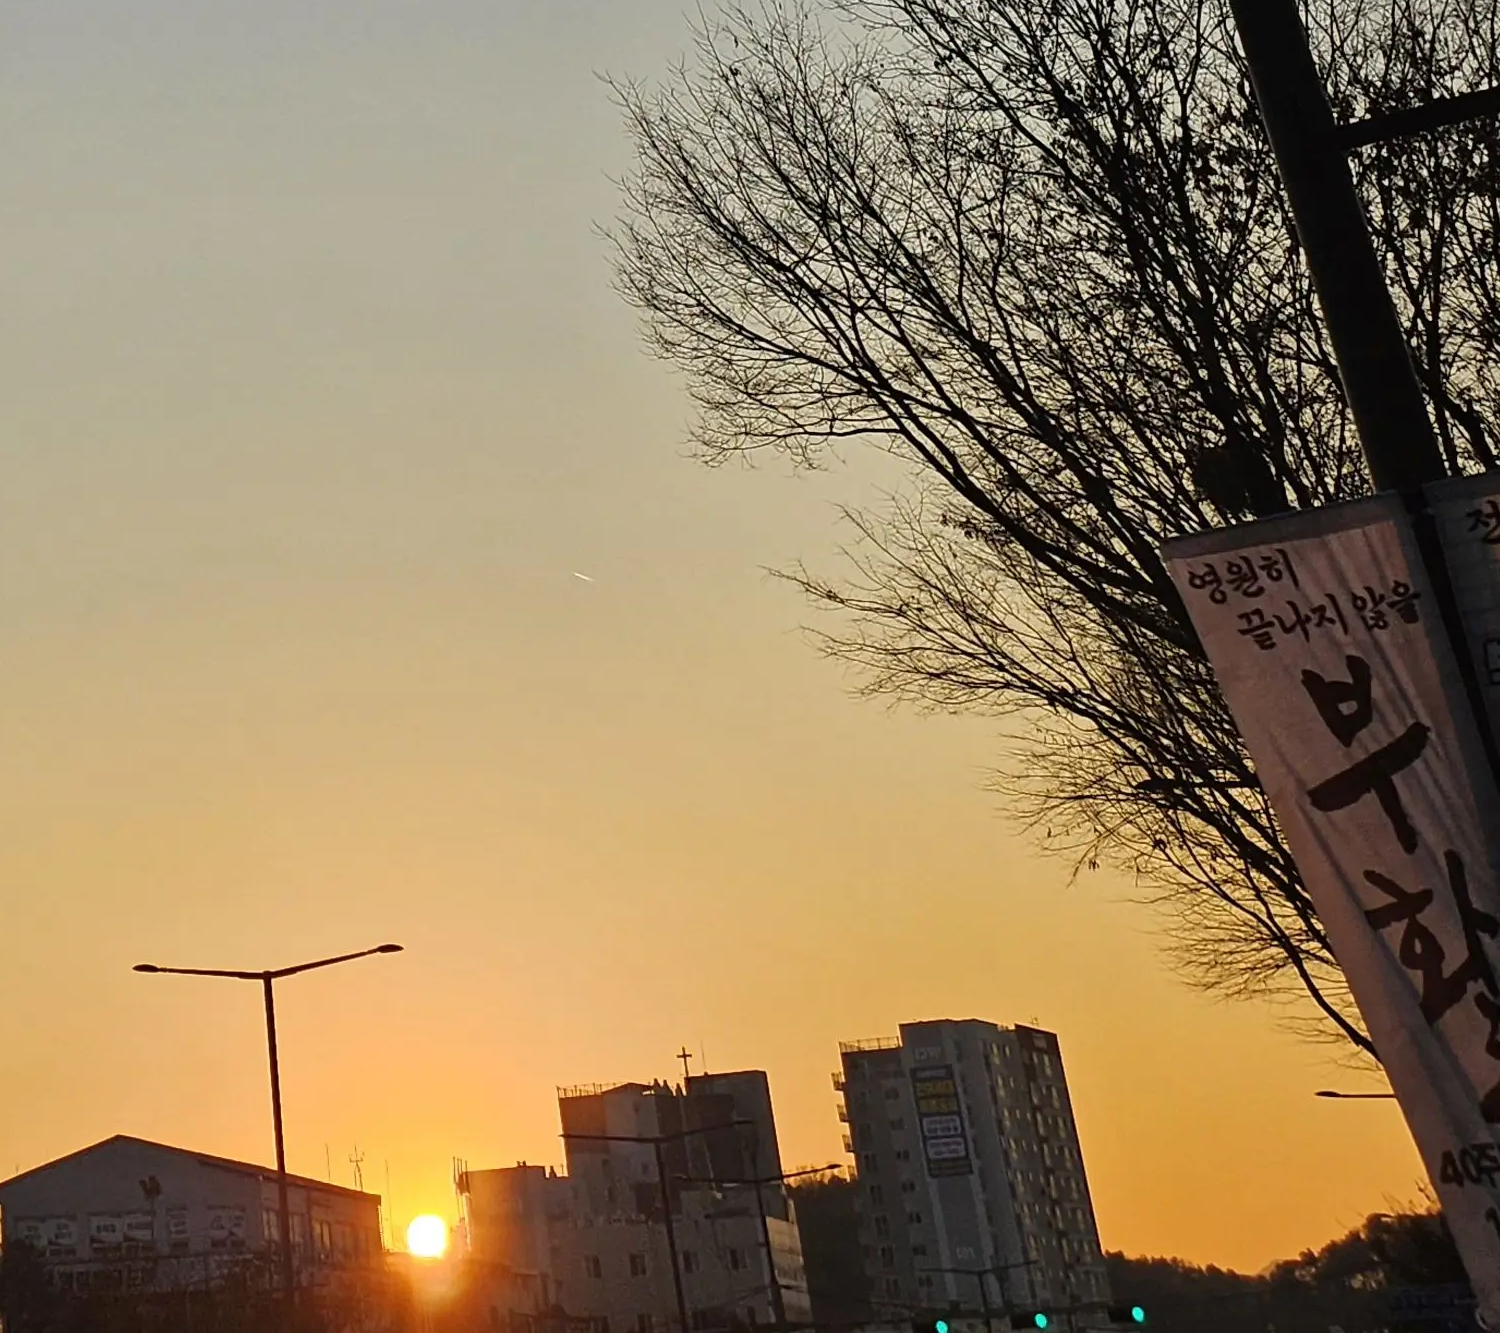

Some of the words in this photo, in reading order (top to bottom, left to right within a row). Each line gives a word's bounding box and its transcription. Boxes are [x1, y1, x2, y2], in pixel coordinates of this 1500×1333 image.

[1187, 549, 1300, 604] 영원히
[1236, 593, 1349, 651] 끝나지
[1352, 579, 1422, 632] 않을
